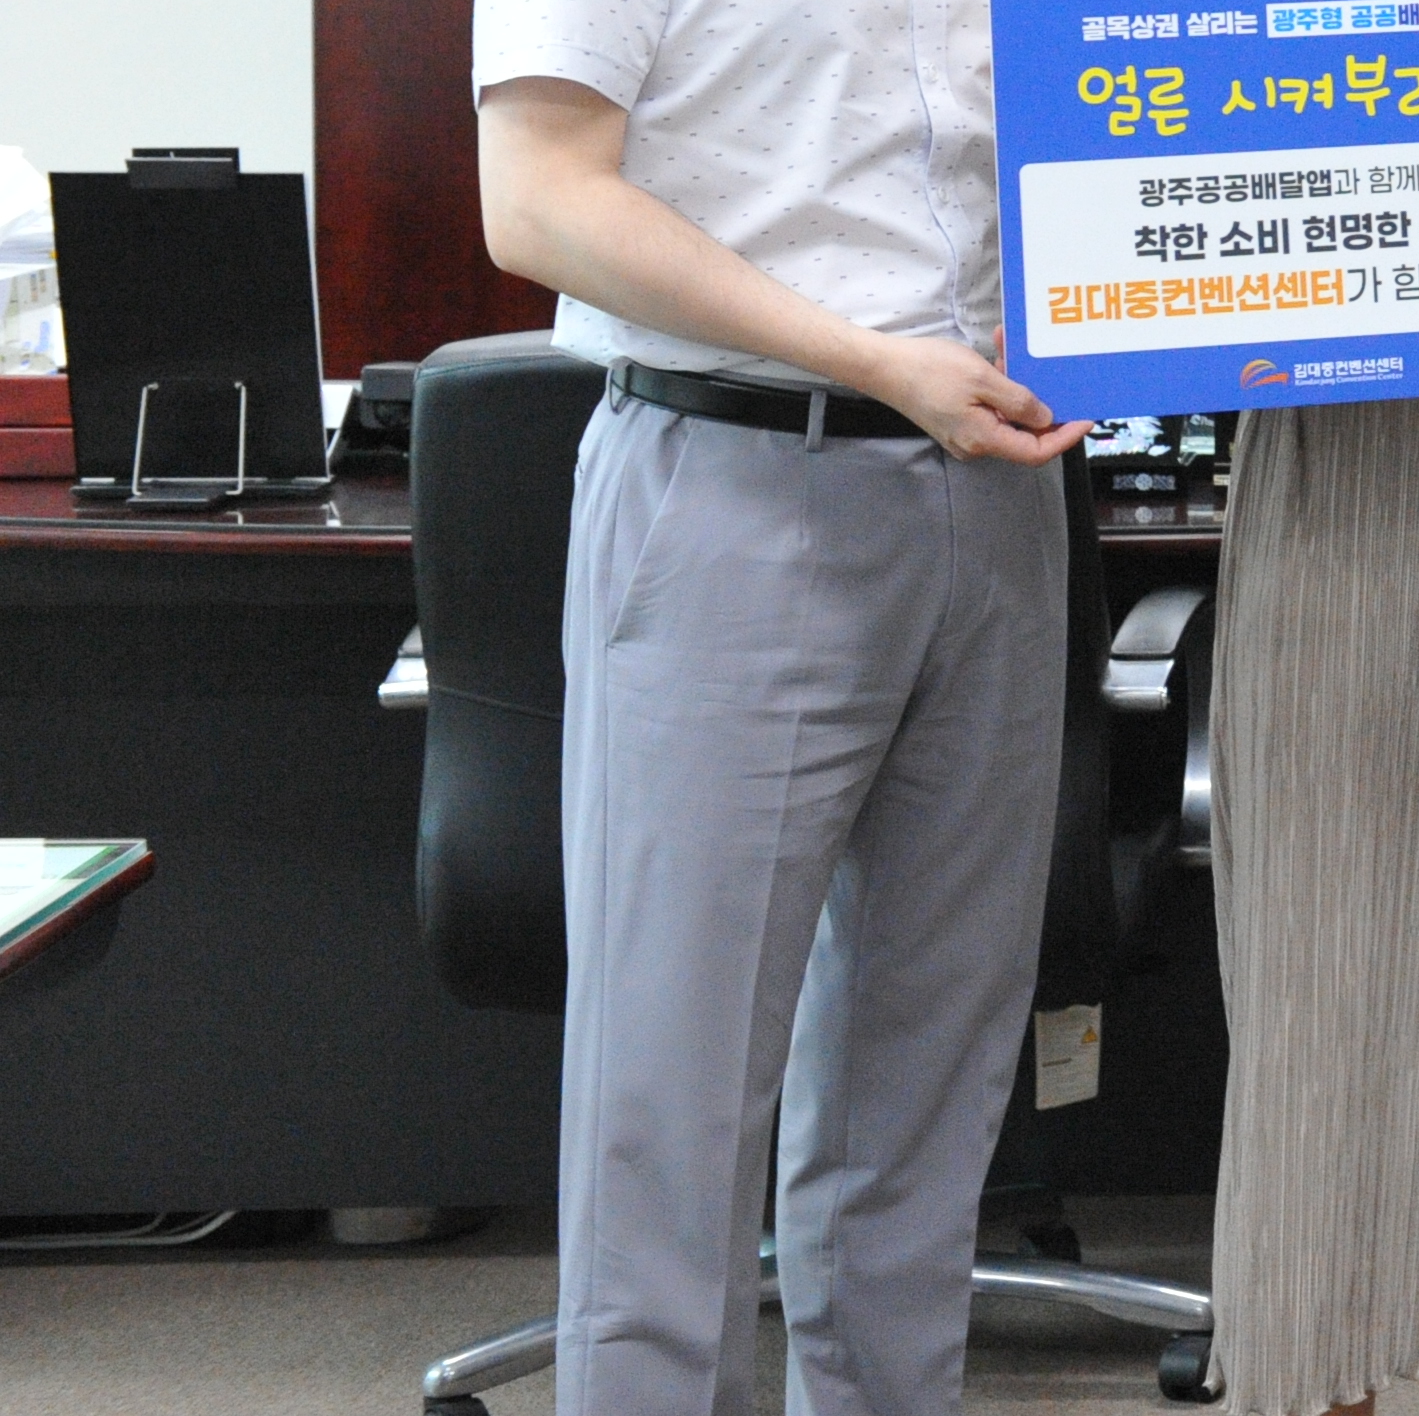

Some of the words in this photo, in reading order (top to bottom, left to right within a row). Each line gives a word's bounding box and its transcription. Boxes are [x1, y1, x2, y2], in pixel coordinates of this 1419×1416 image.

[1082, 11, 1179, 41] 골목상권
[1187, 10, 1257, 36] 살리는
[1272, 4, 1343, 32] 광주형
[1077, 64, 1190, 136] 얼른
[1139, 168, 1361, 207] 광주공공배달앱과
[1135, 224, 1207, 263] 착한
[1220, 219, 1290, 255] 소비
[1303, 212, 1410, 252] 현명한
[1048, 266, 1381, 324] 김대중컨벤션센터가
[1294, 357, 1403, 378] 김대중컨벤션센터
